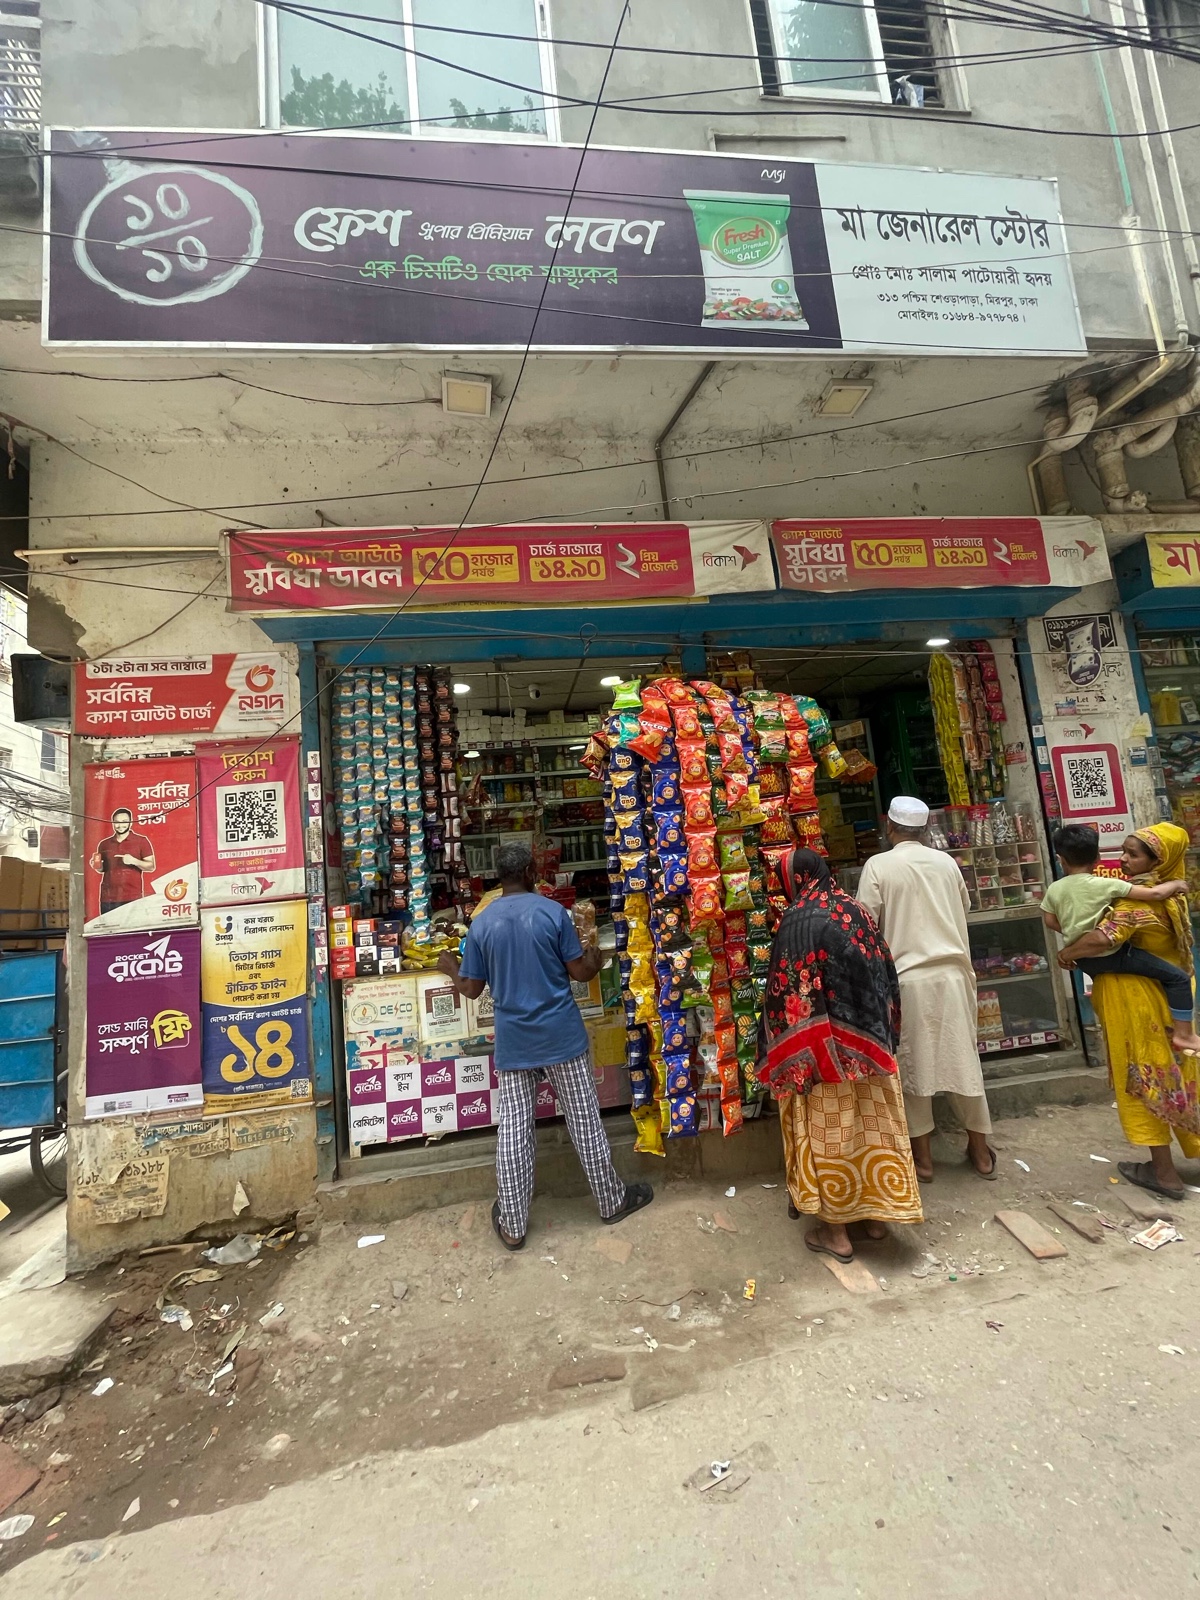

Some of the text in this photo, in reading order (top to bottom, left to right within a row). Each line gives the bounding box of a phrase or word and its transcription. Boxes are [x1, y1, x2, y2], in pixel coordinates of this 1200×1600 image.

[293, 206, 666, 255] ফ্রেশ সুপার প্রিমিয়াম লবণ
[836, 204, 1051, 250] মা জেনারেল স্টোর
[723, 224, 766, 247] Fresh
[736, 249, 762, 262] SALT
[359, 260, 397, 279] এক
[402, 254, 479, 281] চিমটিও
[486, 264, 534, 283] হোক
[917, 266, 957, 283] সালাম
[961, 265, 1020, 286] পাটোয়ারী
[1023, 271, 1053, 287] হৃদয়
[877, 294, 899, 303] ৩১৩
[902, 291, 928, 304] পশ্চিম
[1020, 297, 1039, 307] ঢাকা
[781, 527, 843, 541] ক্যাশ আউটে
[892, 544, 923, 555] হাজার
[931, 537, 984, 548] চার্জ হাজারে
[1010, 542, 1024, 553] প্রিয়
[286, 544, 403, 565] ক্যাশ আউটে
[529, 543, 603, 557] চার্জ হাজারে
[640, 549, 659, 562] প্রিয়
[783, 538, 846, 566] সুবিধা
[992, 537, 1012, 566] ২
[1053, 545, 1079, 559] বিকাশ
[470, 552, 514, 567] হাজার
[615, 542, 640, 579] ২
[641, 560, 679, 573] এজেন্টে
[702, 552, 737, 568] বিকাশ
[894, 555, 911, 564] পর্যন্ত
[244, 561, 403, 596] সুবিধা ডাবল
[470, 567, 496, 578] পর্যন্ত
[786, 563, 848, 584] ডাবল
[93, 660, 207, 674] ১টা ২টা না সব নাম্বারে
[86, 682, 153, 705] সর্বনিম্ন
[238, 694, 284, 711] নগদ
[86, 709, 128, 724] ক্যাশ
[131, 705, 176, 722] আউট
[1062, 728, 1083, 738] বিকাশ
[220, 750, 275, 769] বিকাশ
[232, 768, 267, 782] করুন
[137, 781, 190, 799] সর্বনিম্ন
[137, 798, 190, 811] ক্যাশ আউট
[231, 883, 257, 895] বিকাশ
[162, 903, 191, 918] নগদ
[244, 917, 255, 925] কম
[243, 924, 294, 935] নিরাপদ লেনদেন
[115, 953, 150, 962] ROCKET
[229, 949, 282, 962] তিতাস গ্যাস
[107, 950, 183, 983] রকেট
[248, 972, 262, 980] এবং
[225, 978, 287, 995] ট্রাফিক ফাইন
[232, 993, 255, 1003] পেমেন্ট
[256, 992, 270, 1001] করা
[228, 1010, 256, 1022] সর্বনিম্ন
[98, 1016, 149, 1035] সেন্ড মানি
[150, 1009, 192, 1047] ফ্রি
[98, 1031, 149, 1054] সম্পূর্ণ
[463, 1064, 482, 1074] ক্যাশ
[393, 1072, 413, 1082] ক্যাশ
[461, 1071, 485, 1084] আউট
[397, 1082, 410, 1092] ইন
[439, 1102, 455, 1112] মানি
[353, 1115, 386, 1129] রেমিটেন্স
